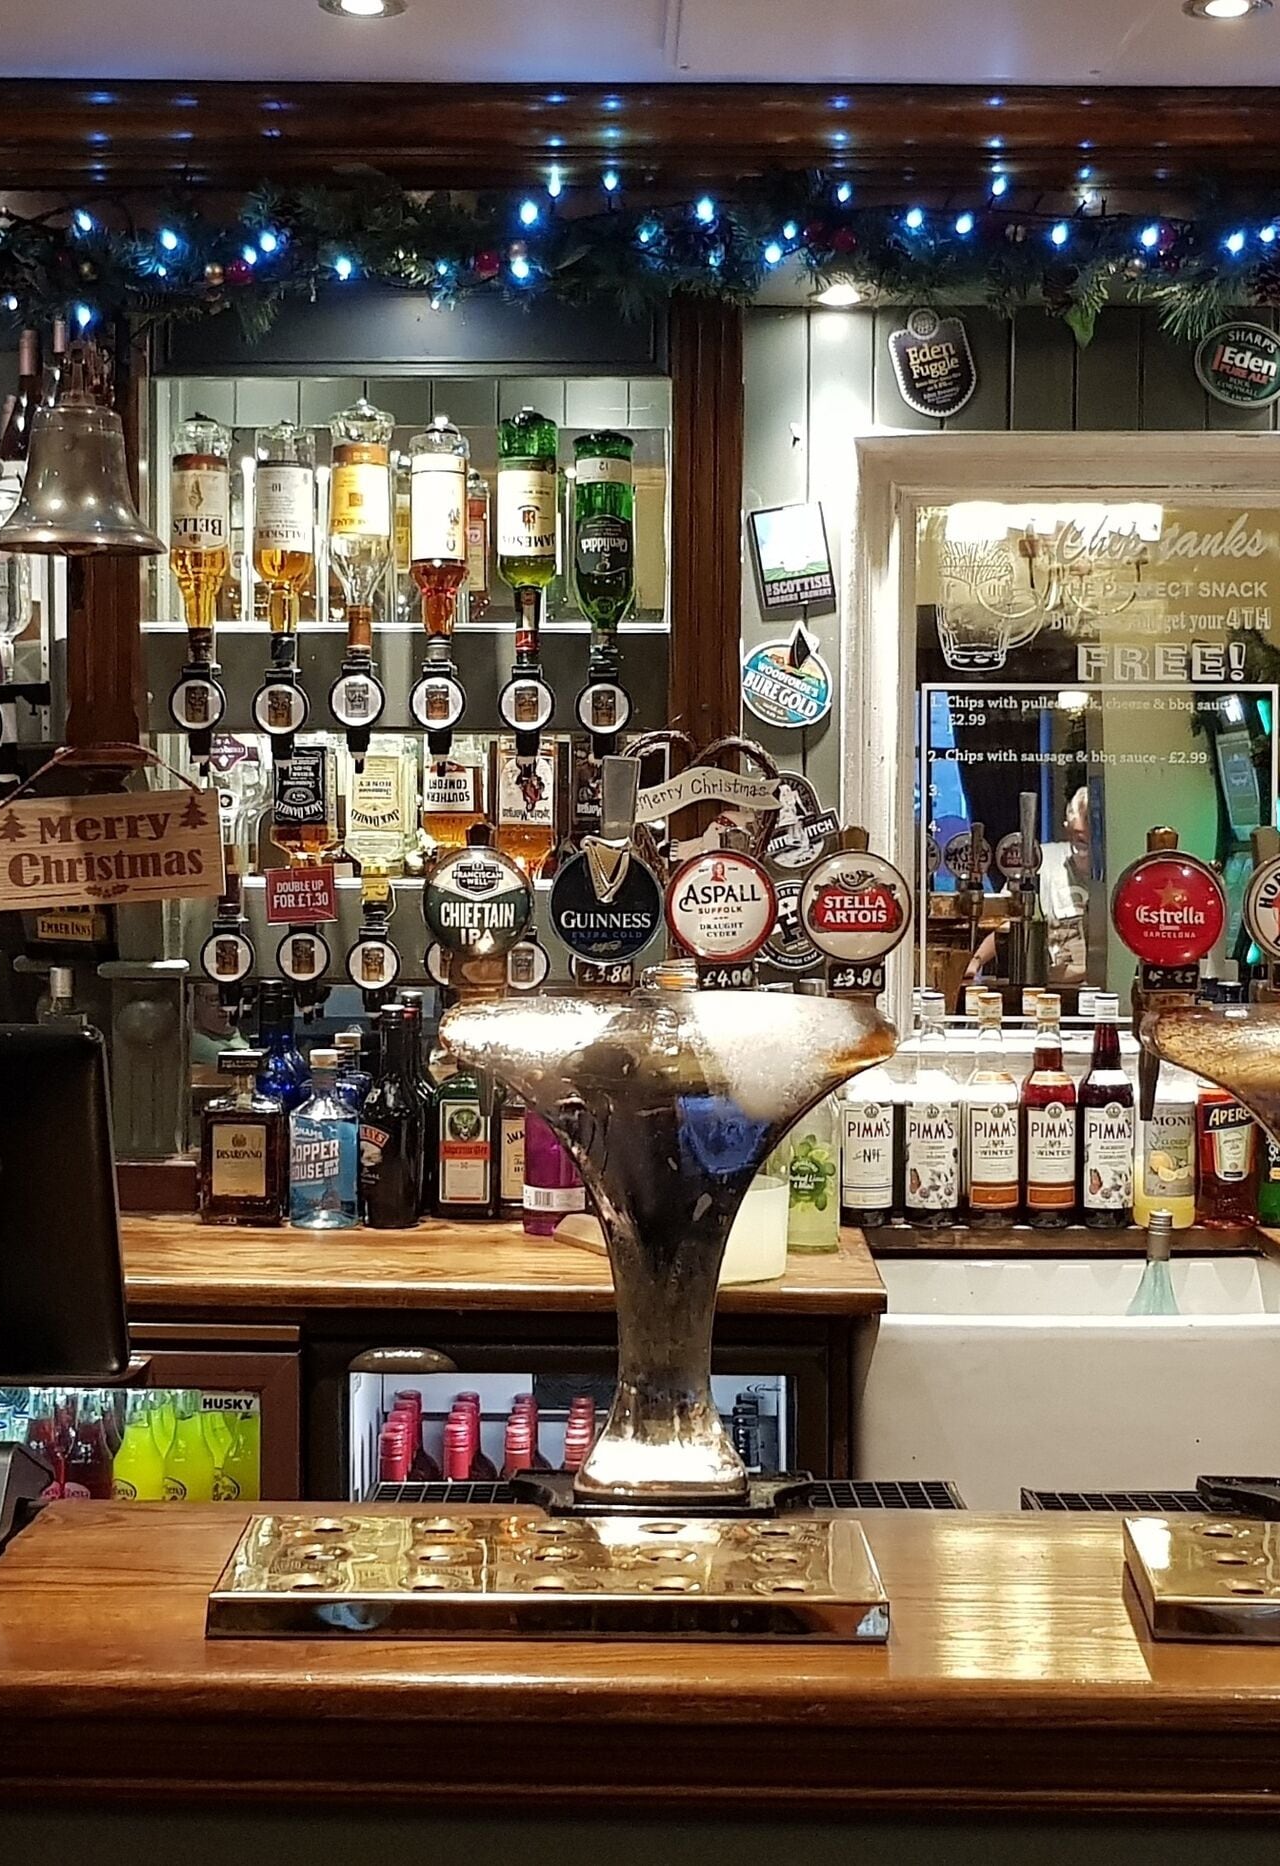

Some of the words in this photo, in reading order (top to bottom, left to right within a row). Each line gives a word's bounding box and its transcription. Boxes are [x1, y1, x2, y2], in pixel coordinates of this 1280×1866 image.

[1227, 330, 1277, 354] SHARP'S
[906, 342, 956, 365] Eden
[1221, 346, 1277, 377] Eden
[911, 357, 960, 379] Fuggle
[173, 518, 222, 536] BELL'S
[581, 537, 628, 553] Glenfiddich
[772, 575, 831, 597] SCOTTISH
[1198, 581, 1268, 598] SNACK
[1166, 612, 1187, 633] get
[1189, 614, 1225, 633] your
[1226, 606, 1271, 631] 4TH
[1077, 642, 1247, 681] FREE!
[757, 661, 819, 698] WOODFORDE'S
[743, 671, 780, 701] BURE
[779, 688, 818, 717] GOLD
[946, 696, 984, 710] Chips
[987, 696, 1019, 710] with
[1153, 699, 1165, 711] &
[1168, 699, 1194, 713] bbq
[948, 714, 986, 727] £2.99
[927, 750, 939, 763] 2.
[945, 749, 984, 765] Chips
[987, 749, 1017, 763] with
[1020, 752, 1072, 767] sausage
[1076, 752, 1088, 764] &
[1091, 752, 1116, 767] bbq
[1120, 753, 1157, 764] sauce
[1168, 751, 1208, 765] £2.99
[428, 779, 468, 790] COMFORT
[928, 784, 941, 797] 3.
[637, 783, 683, 811] Merry
[691, 777, 768, 798] Christmas
[37, 812, 171, 845] Merry
[928, 820, 942, 833] 4.
[7, 847, 204, 888] Christmas
[451, 870, 503, 880] FRANCISCAN
[276, 881, 311, 894] DOUBLE
[312, 881, 324, 892] UP
[467, 878, 488, 887] WELL
[273, 894, 296, 908] FOR
[298, 892, 329, 908] £1.30
[679, 883, 761, 913] ASPALL
[823, 895, 886, 909] STELLA
[440, 902, 515, 928] CHIEFTAIN
[698, 906, 742, 914] SUFFOLK
[823, 910, 888, 924] ARTOIS
[1135, 906, 1205, 925] Estrella
[40, 921, 70, 935] EMBER
[560, 910, 651, 930] GUINNESS
[699, 922, 744, 931] DRAUGHT
[461, 930, 495, 946] IPA
[571, 931, 610, 939] EXTRA
[612, 931, 643, 939] COLD
[1143, 931, 1196, 939] BARCELONA
[582, 965, 632, 983] £3.80
[702, 968, 753, 987] £4.00
[847, 1118, 891, 1138] PIMM'S
[909, 1119, 954, 1139] PIMM'S
[974, 1118, 1017, 1138] PIMM'S
[1031, 1118, 1074, 1138] PIMM'S
[1089, 1118, 1132, 1139] PIMM'S
[216, 1149, 262, 1160] DISARONNO
[202, 1398, 254, 1411] HUSKY
